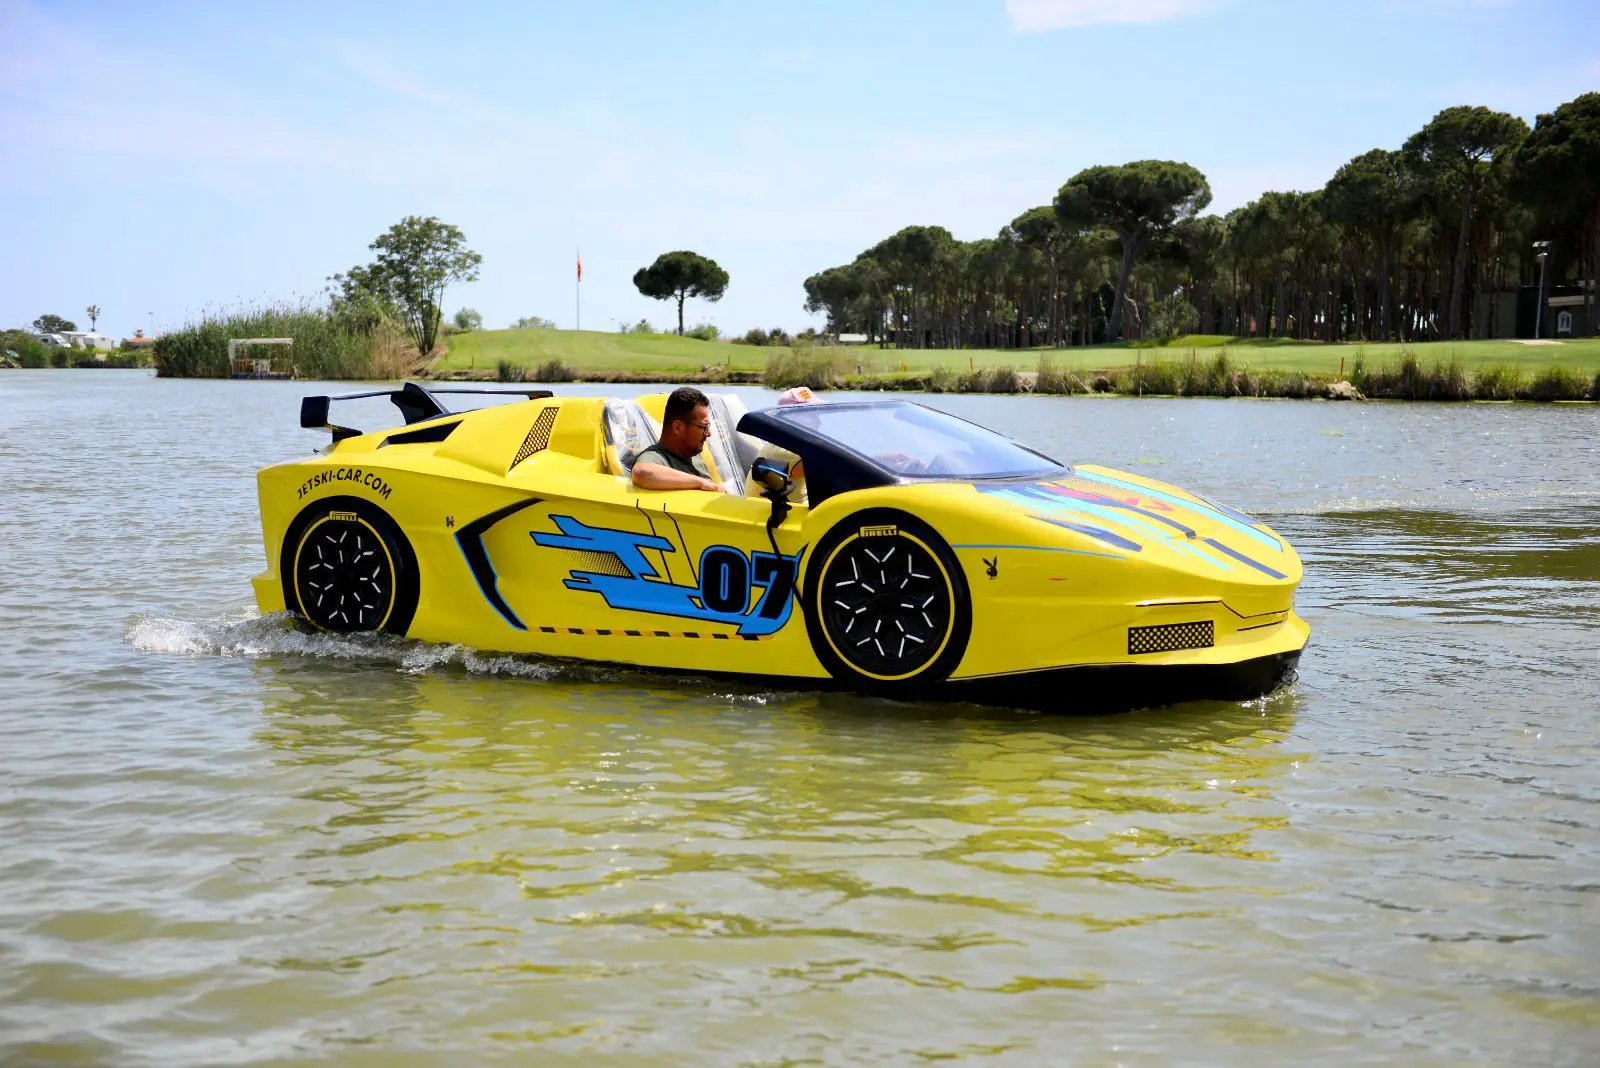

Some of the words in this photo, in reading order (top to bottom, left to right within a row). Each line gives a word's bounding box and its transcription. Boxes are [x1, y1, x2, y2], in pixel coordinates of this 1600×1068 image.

[297, 468, 393, 500] JETSKI-CAR.COM
[329, 511, 357, 521] PIRELLI
[860, 525, 897, 537] PIRELLI
[701, 547, 798, 620] 07
